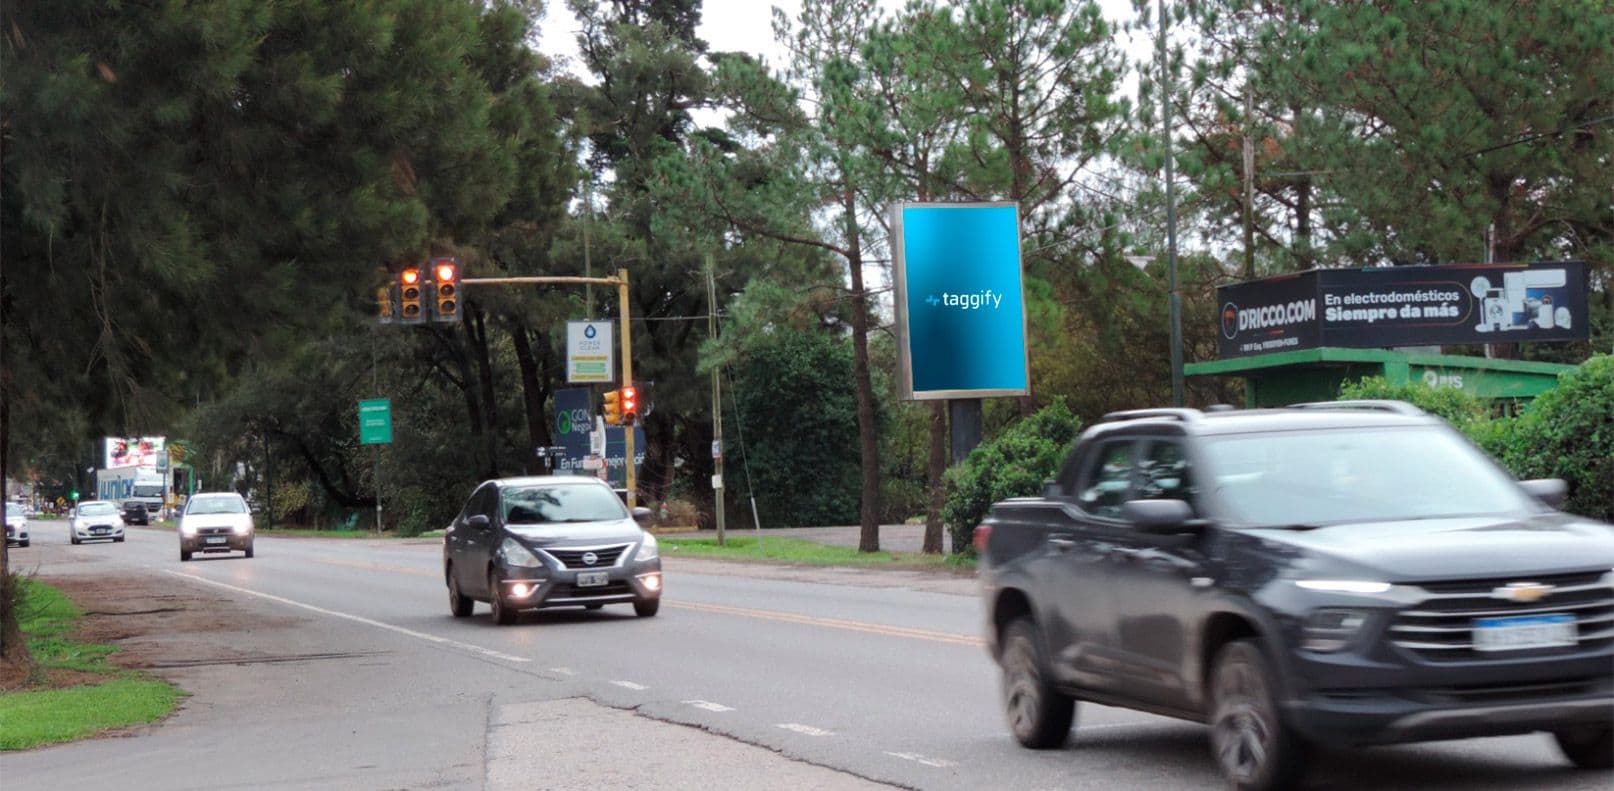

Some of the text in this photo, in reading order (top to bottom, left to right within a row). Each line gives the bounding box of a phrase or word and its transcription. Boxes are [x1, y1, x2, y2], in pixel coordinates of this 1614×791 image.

[943, 290, 1002, 310] taggify
[1324, 290, 1460, 305] En electrodomésticos
[1325, 303, 1459, 323] Siempre da más
